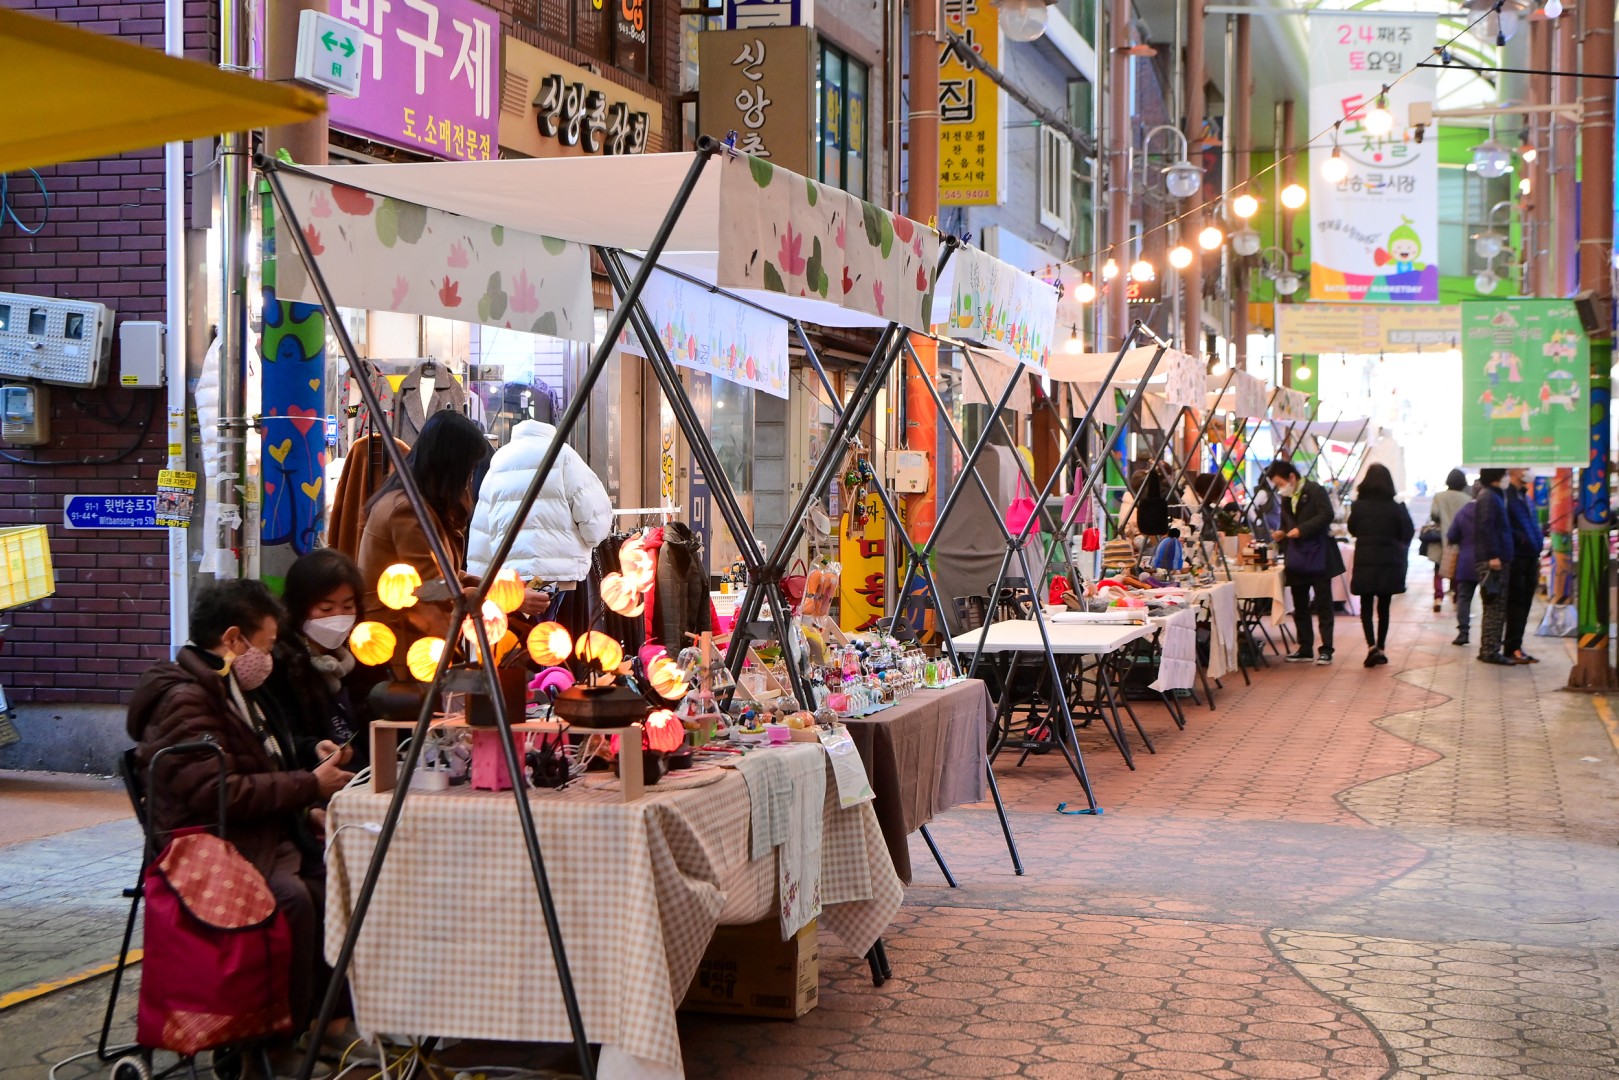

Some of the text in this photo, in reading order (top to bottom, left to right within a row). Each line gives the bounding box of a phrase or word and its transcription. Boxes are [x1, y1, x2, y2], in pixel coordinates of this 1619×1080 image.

[1349, 51, 1403, 74] 토요일
[538, 74, 650, 154] 신앙촌상회
[84, 502, 99, 511] 91-1
[71, 512, 91, 520] 91-44
